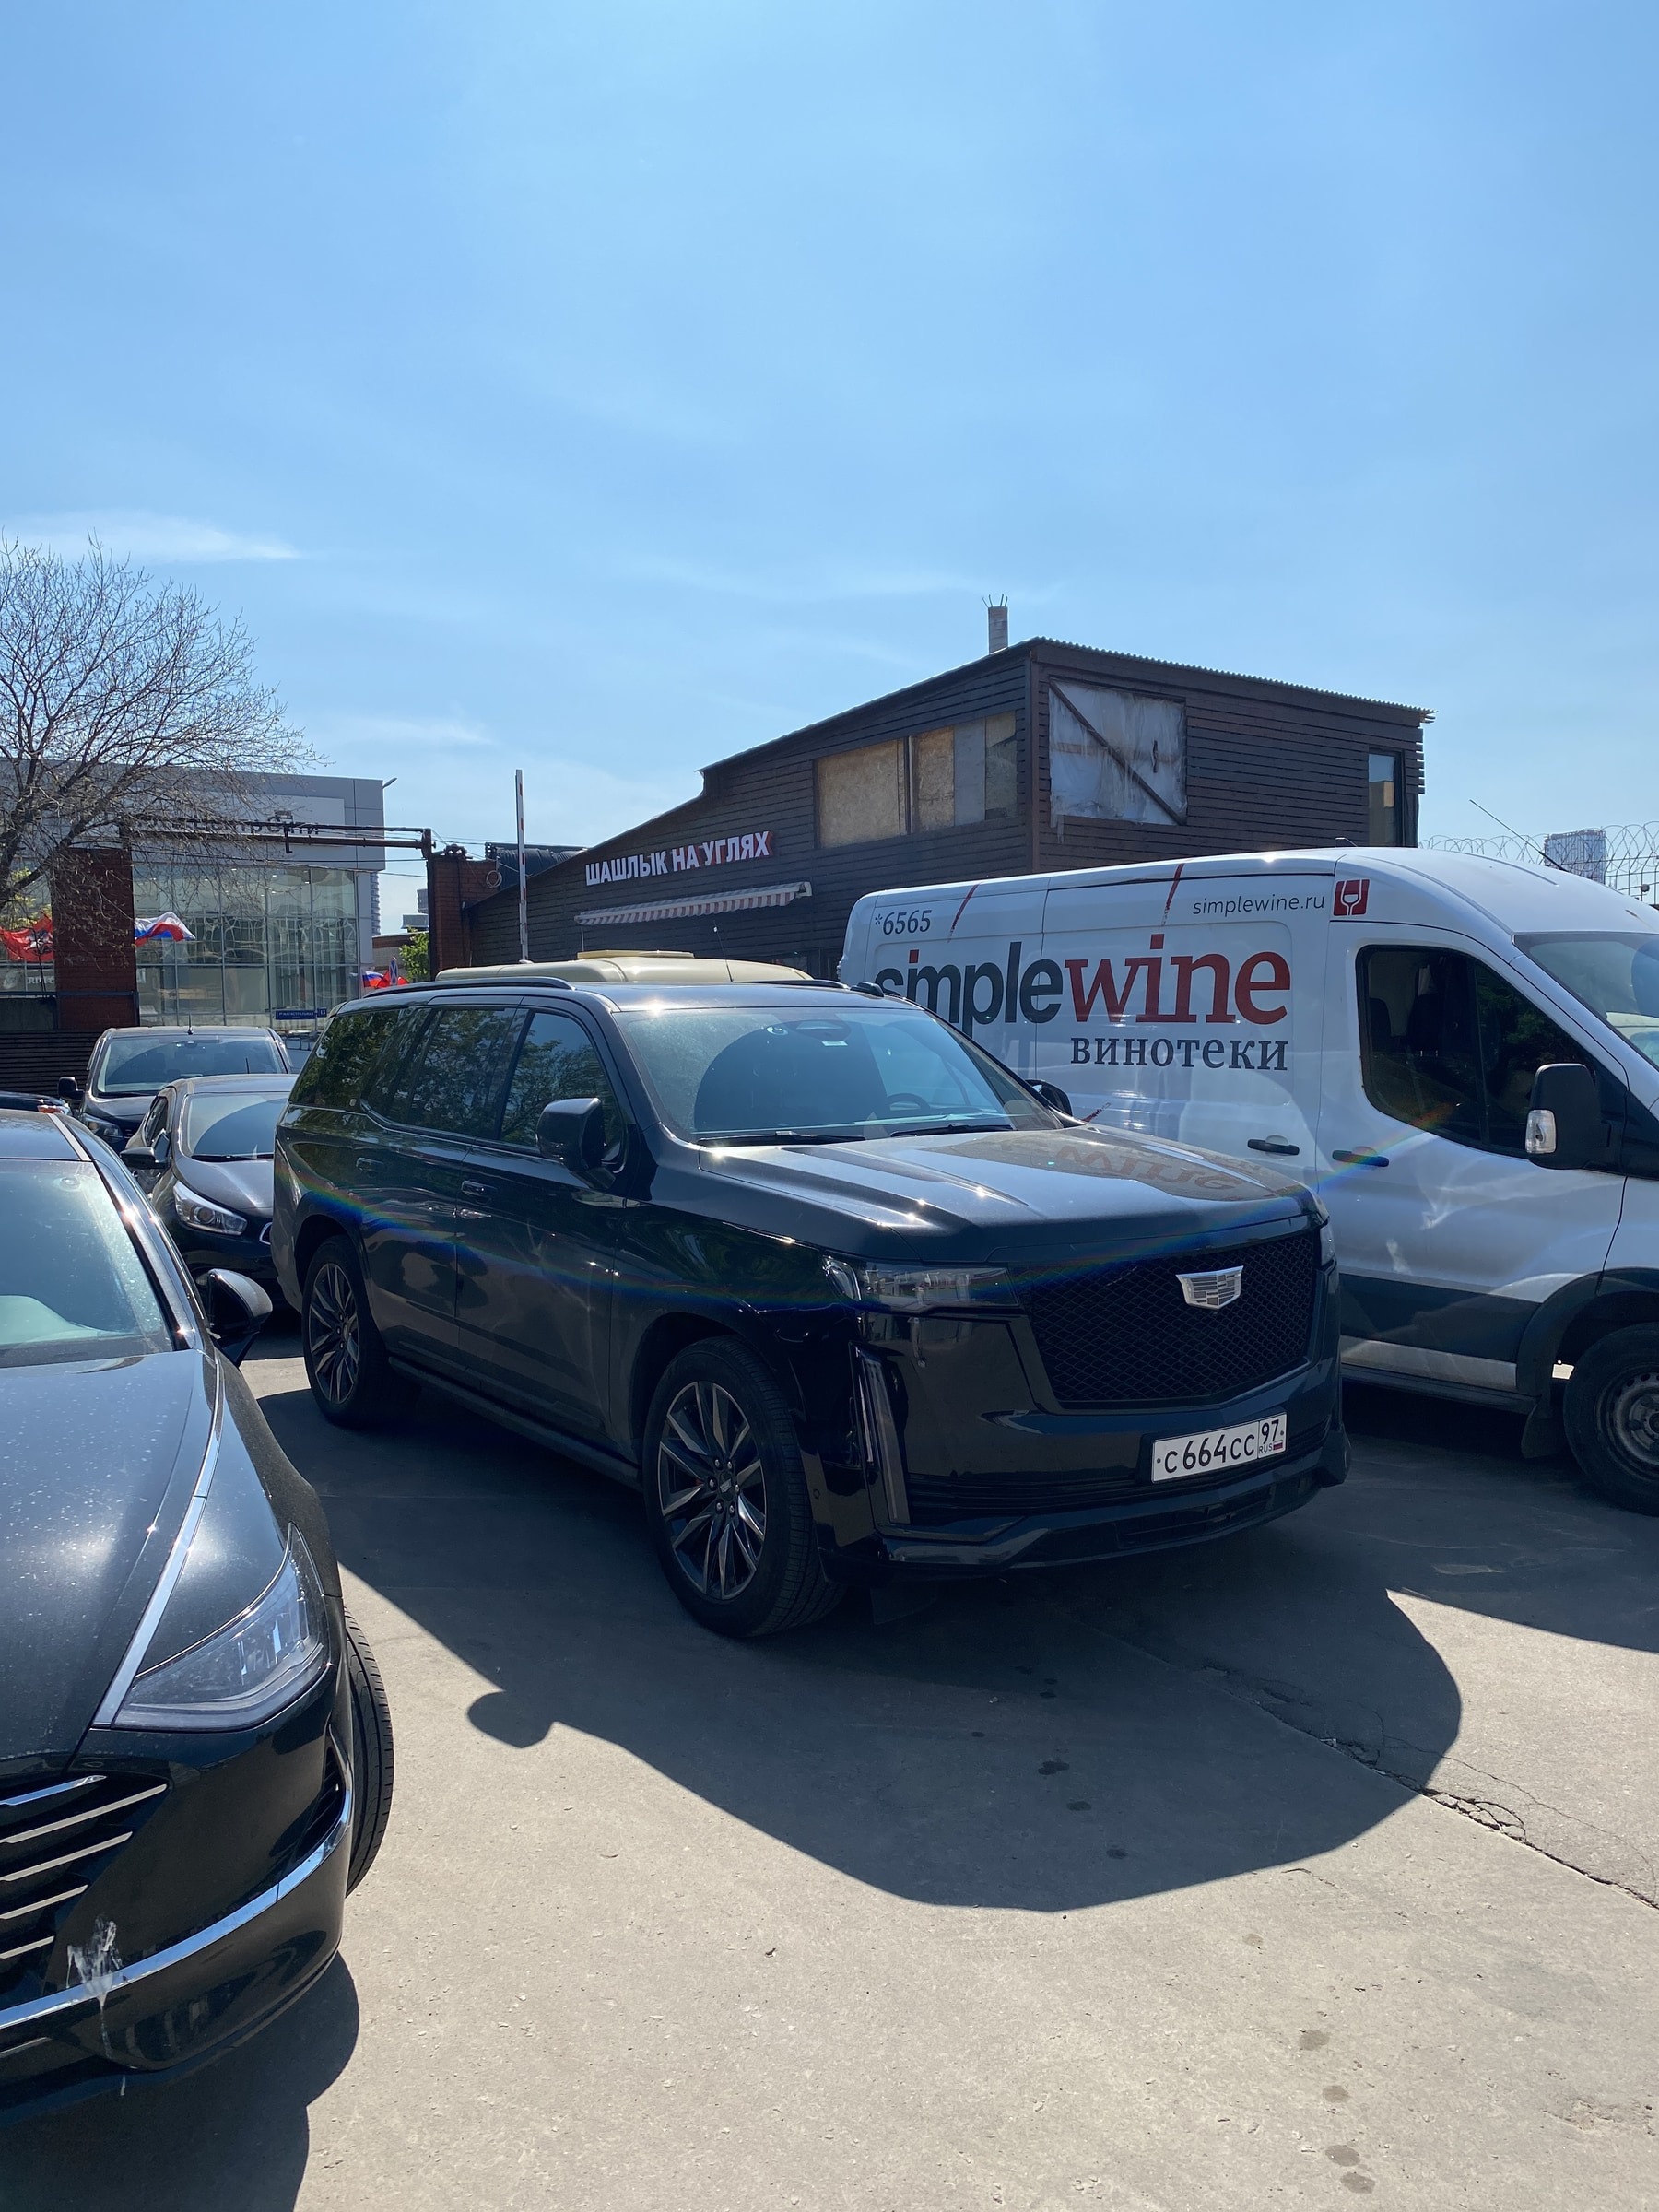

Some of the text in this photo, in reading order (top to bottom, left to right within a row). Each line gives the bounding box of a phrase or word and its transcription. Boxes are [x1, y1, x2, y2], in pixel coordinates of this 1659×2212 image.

[585, 830, 771, 886] ШАШЛЫК НА УГЛЯХ
[1193, 894, 1325, 917] simplewine.ru
[1071, 1037, 1288, 1071] винотеки
[1261, 1419, 1279, 1444] 97
[1259, 1443, 1273, 1453] RUS
